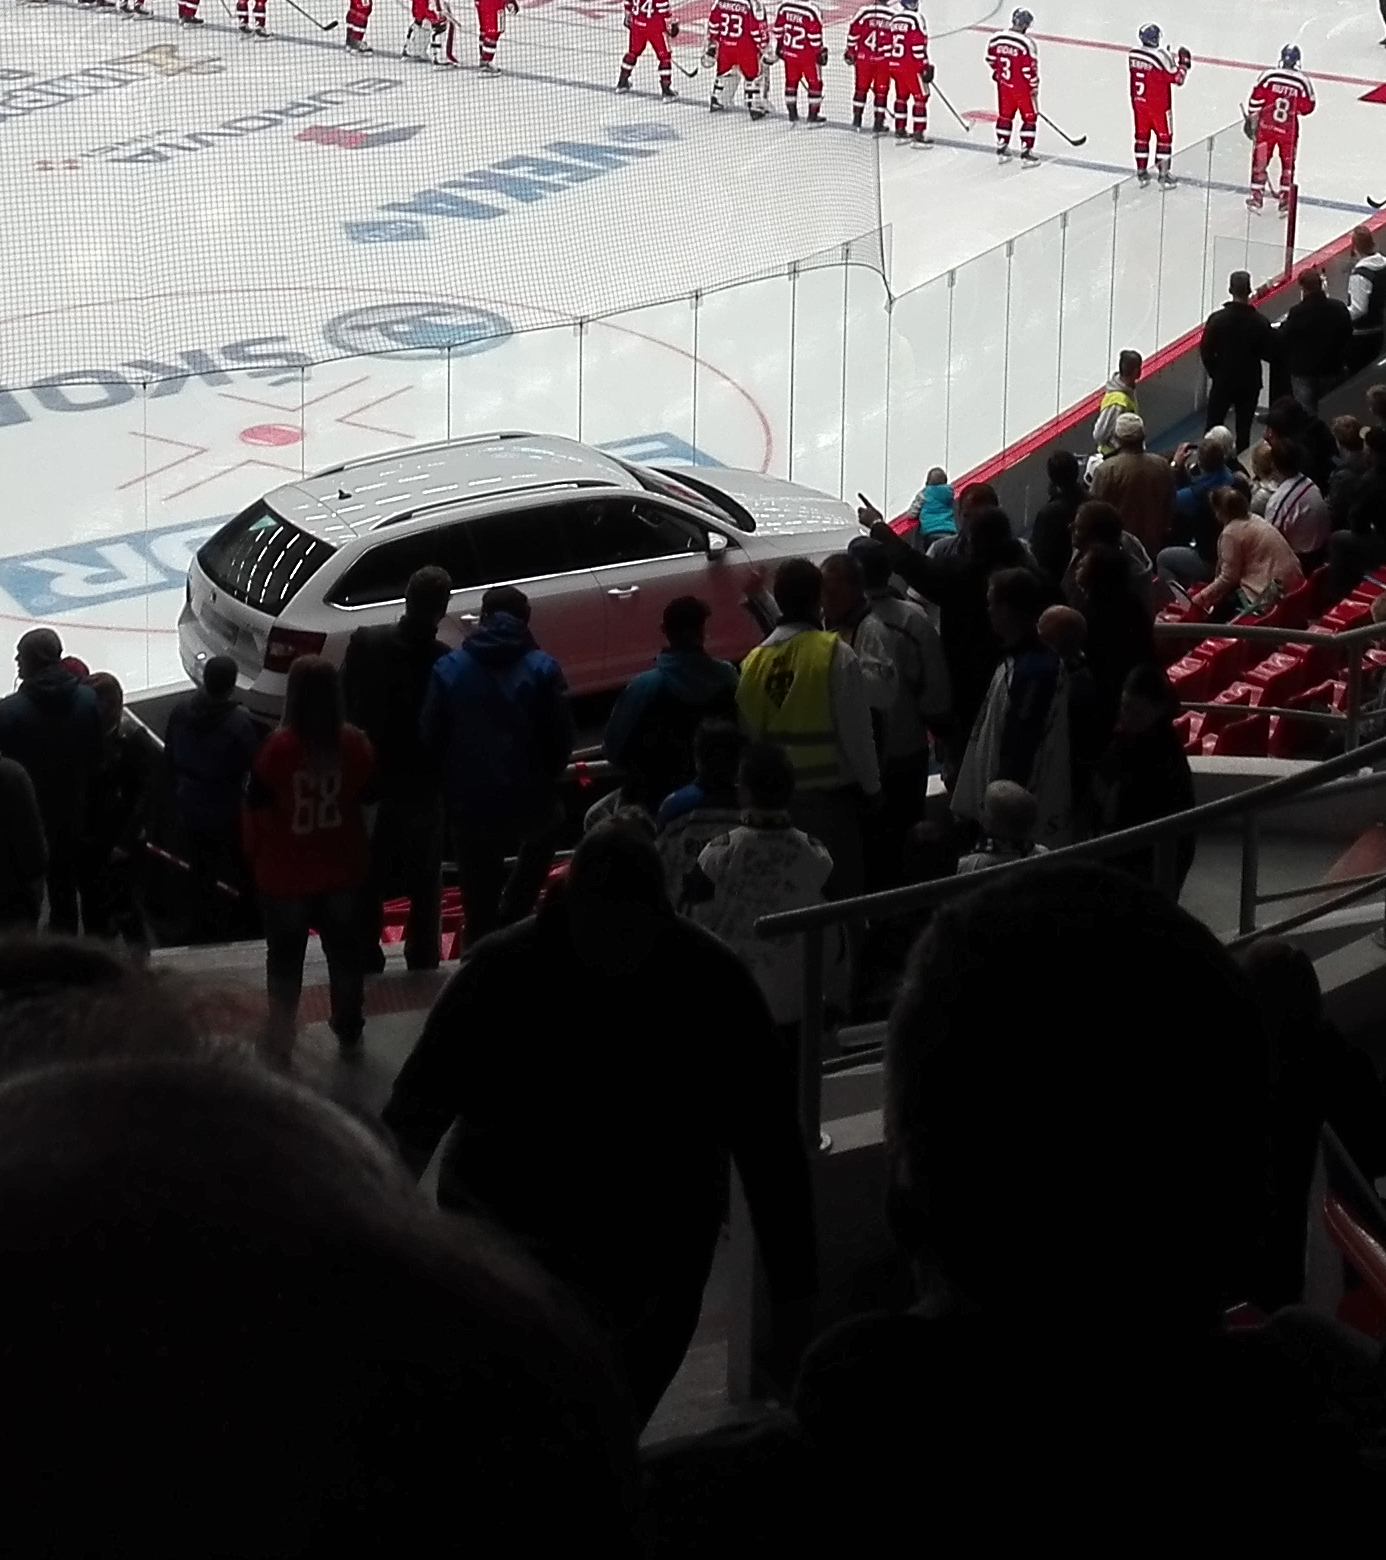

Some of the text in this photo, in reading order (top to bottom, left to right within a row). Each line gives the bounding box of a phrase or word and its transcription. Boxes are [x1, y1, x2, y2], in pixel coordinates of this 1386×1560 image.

[719, 12, 743, 38] 33
[1000, 57, 1011, 81] 3
[1272, 96, 1291, 124] 8
[377, 140, 660, 221] VEKA
